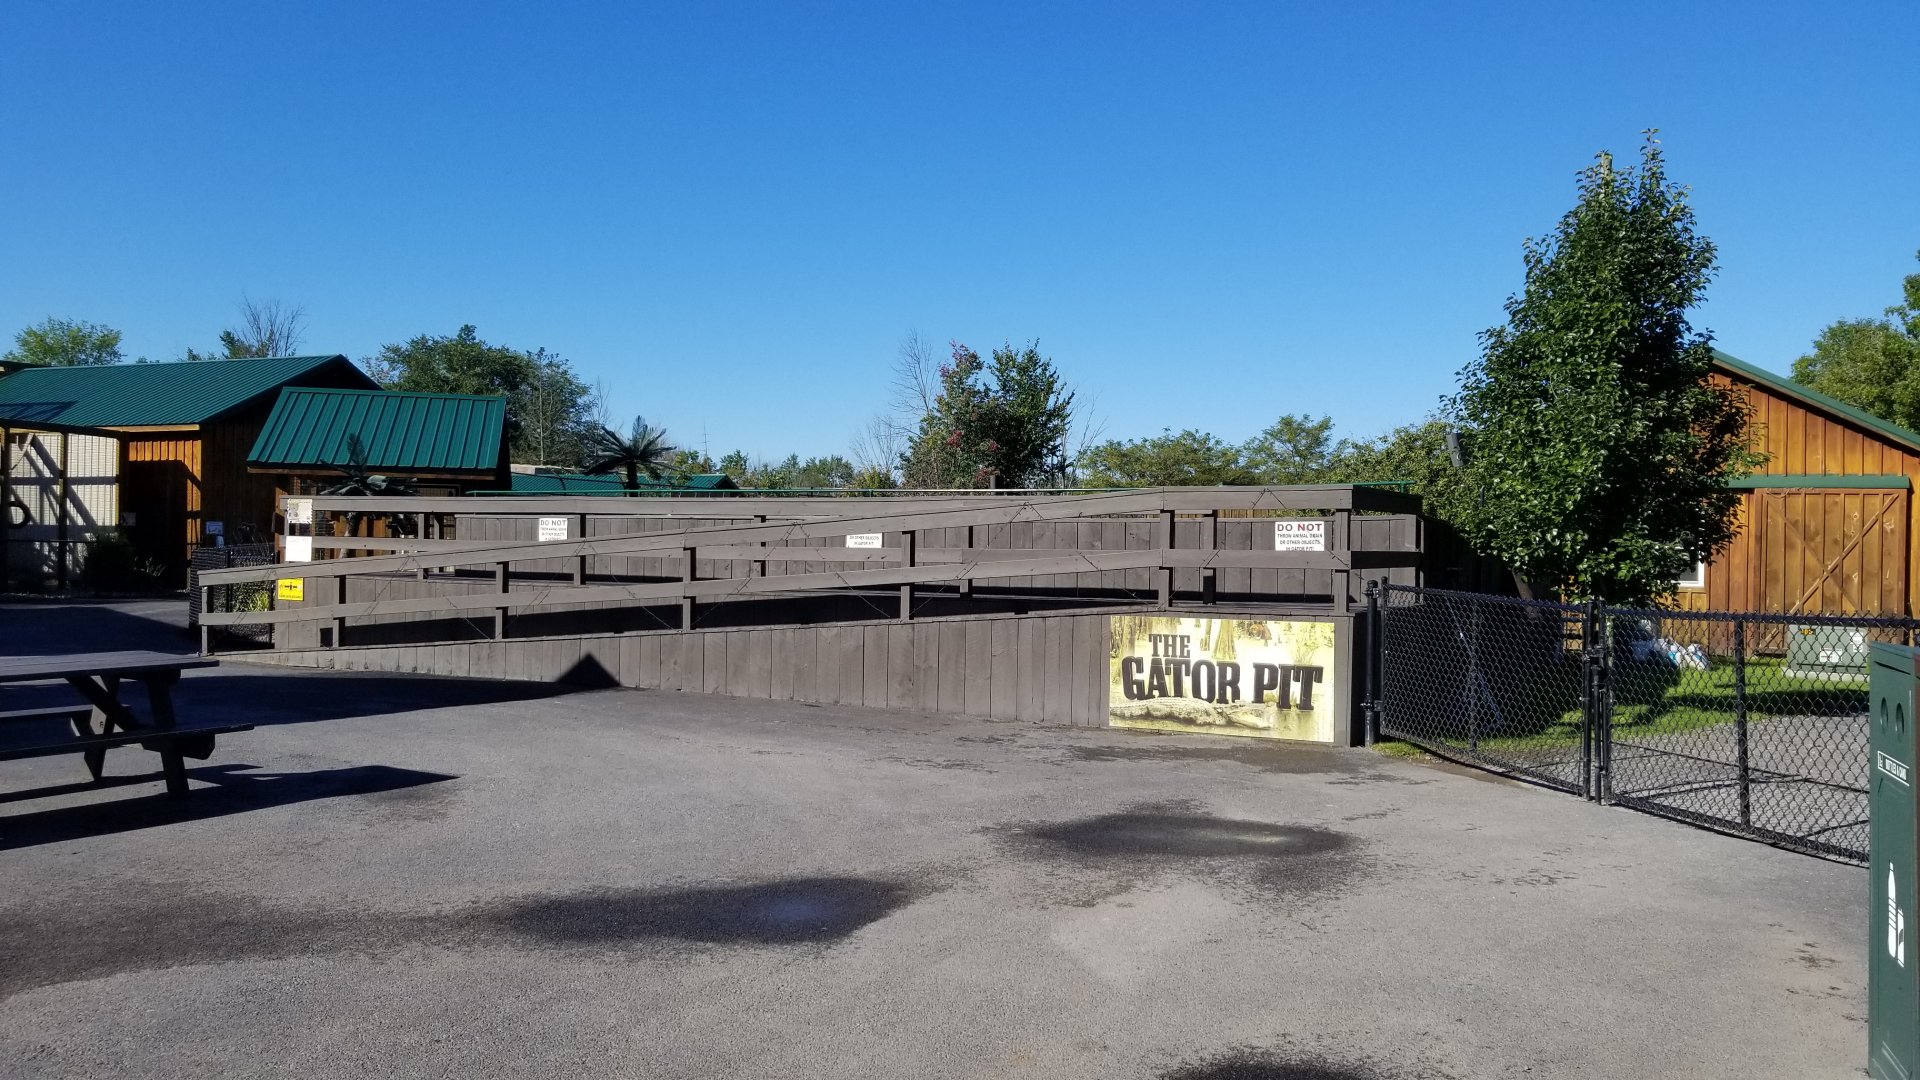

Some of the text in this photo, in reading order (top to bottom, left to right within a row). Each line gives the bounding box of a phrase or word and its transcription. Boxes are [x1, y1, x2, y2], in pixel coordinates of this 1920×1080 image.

[1277, 523, 1323, 532] DO NOT
[1149, 633, 1191, 658] THE
[1121, 656, 1324, 711] GATOR PIT
